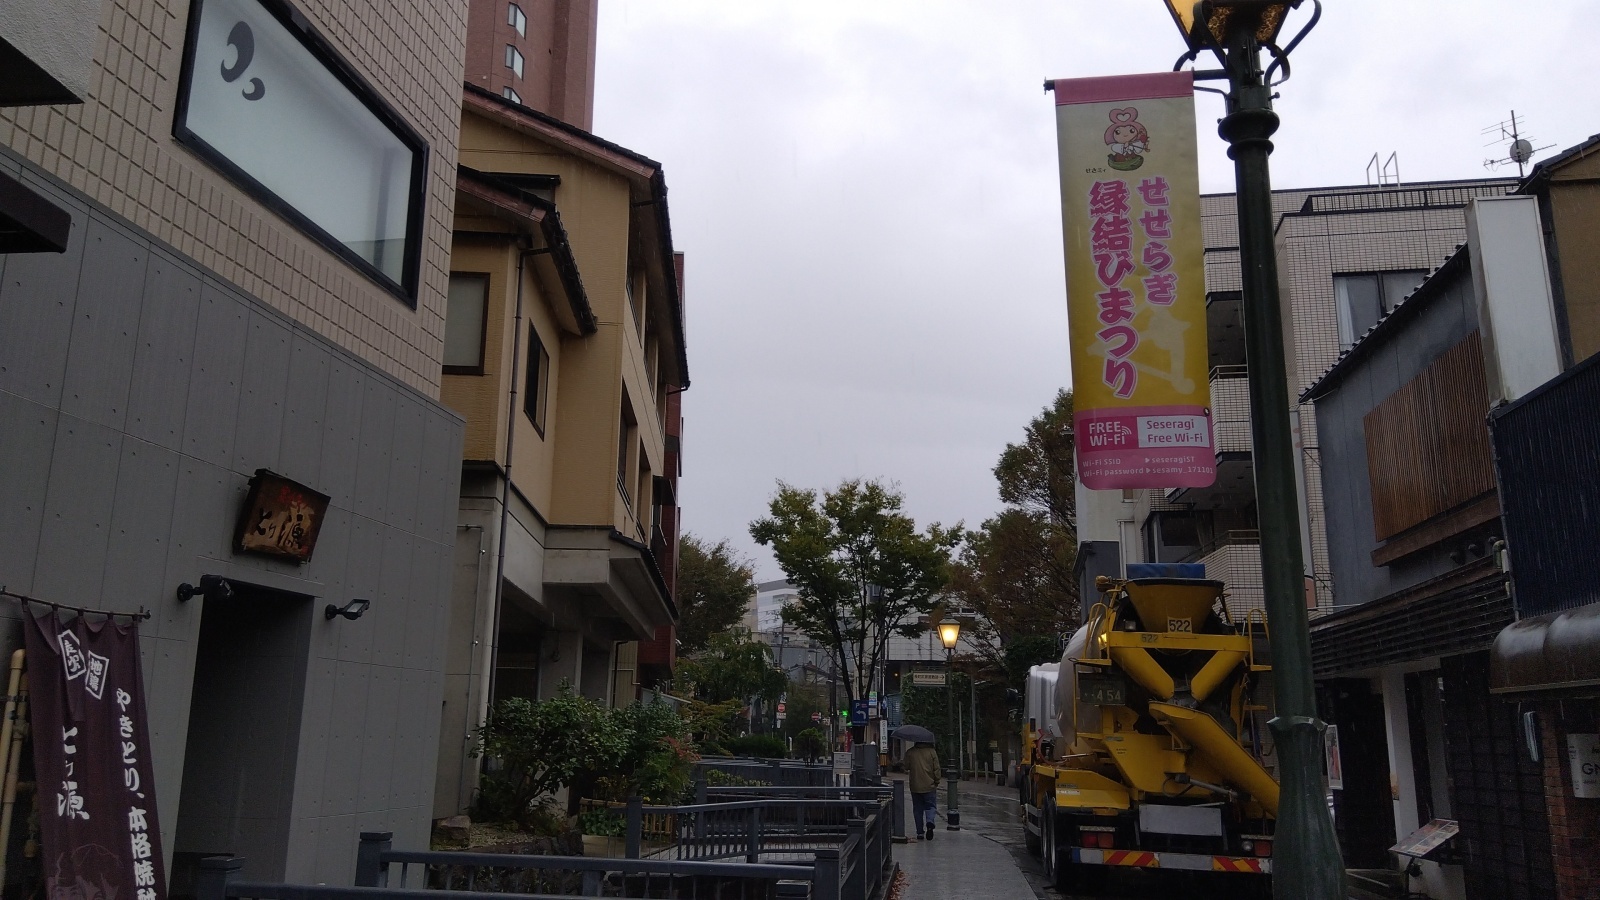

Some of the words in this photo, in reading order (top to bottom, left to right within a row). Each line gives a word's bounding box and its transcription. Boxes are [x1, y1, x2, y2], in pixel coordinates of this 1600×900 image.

[1136, 175, 1178, 305] せせらぎ
[1088, 180, 1137, 398] 縁結びまつり
[1088, 421, 1121, 434] FREE
[1146, 418, 1195, 431] Seseragi
[1089, 433, 1126, 447] Wi-Fi
[1147, 433, 1172, 443] Free
[1174, 432, 1204, 443] Wi-Fi
[1082, 459, 1102, 467] Wi-Fi
[1103, 458, 1121, 466] SSID
[1151, 456, 1195, 464] seseragiST
[1083, 469, 1103, 478] Wi-Fi
[1104, 467, 1144, 477] password
[1152, 466, 1214, 474] sesamy_171101
[1168, 619, 1191, 632] 522
